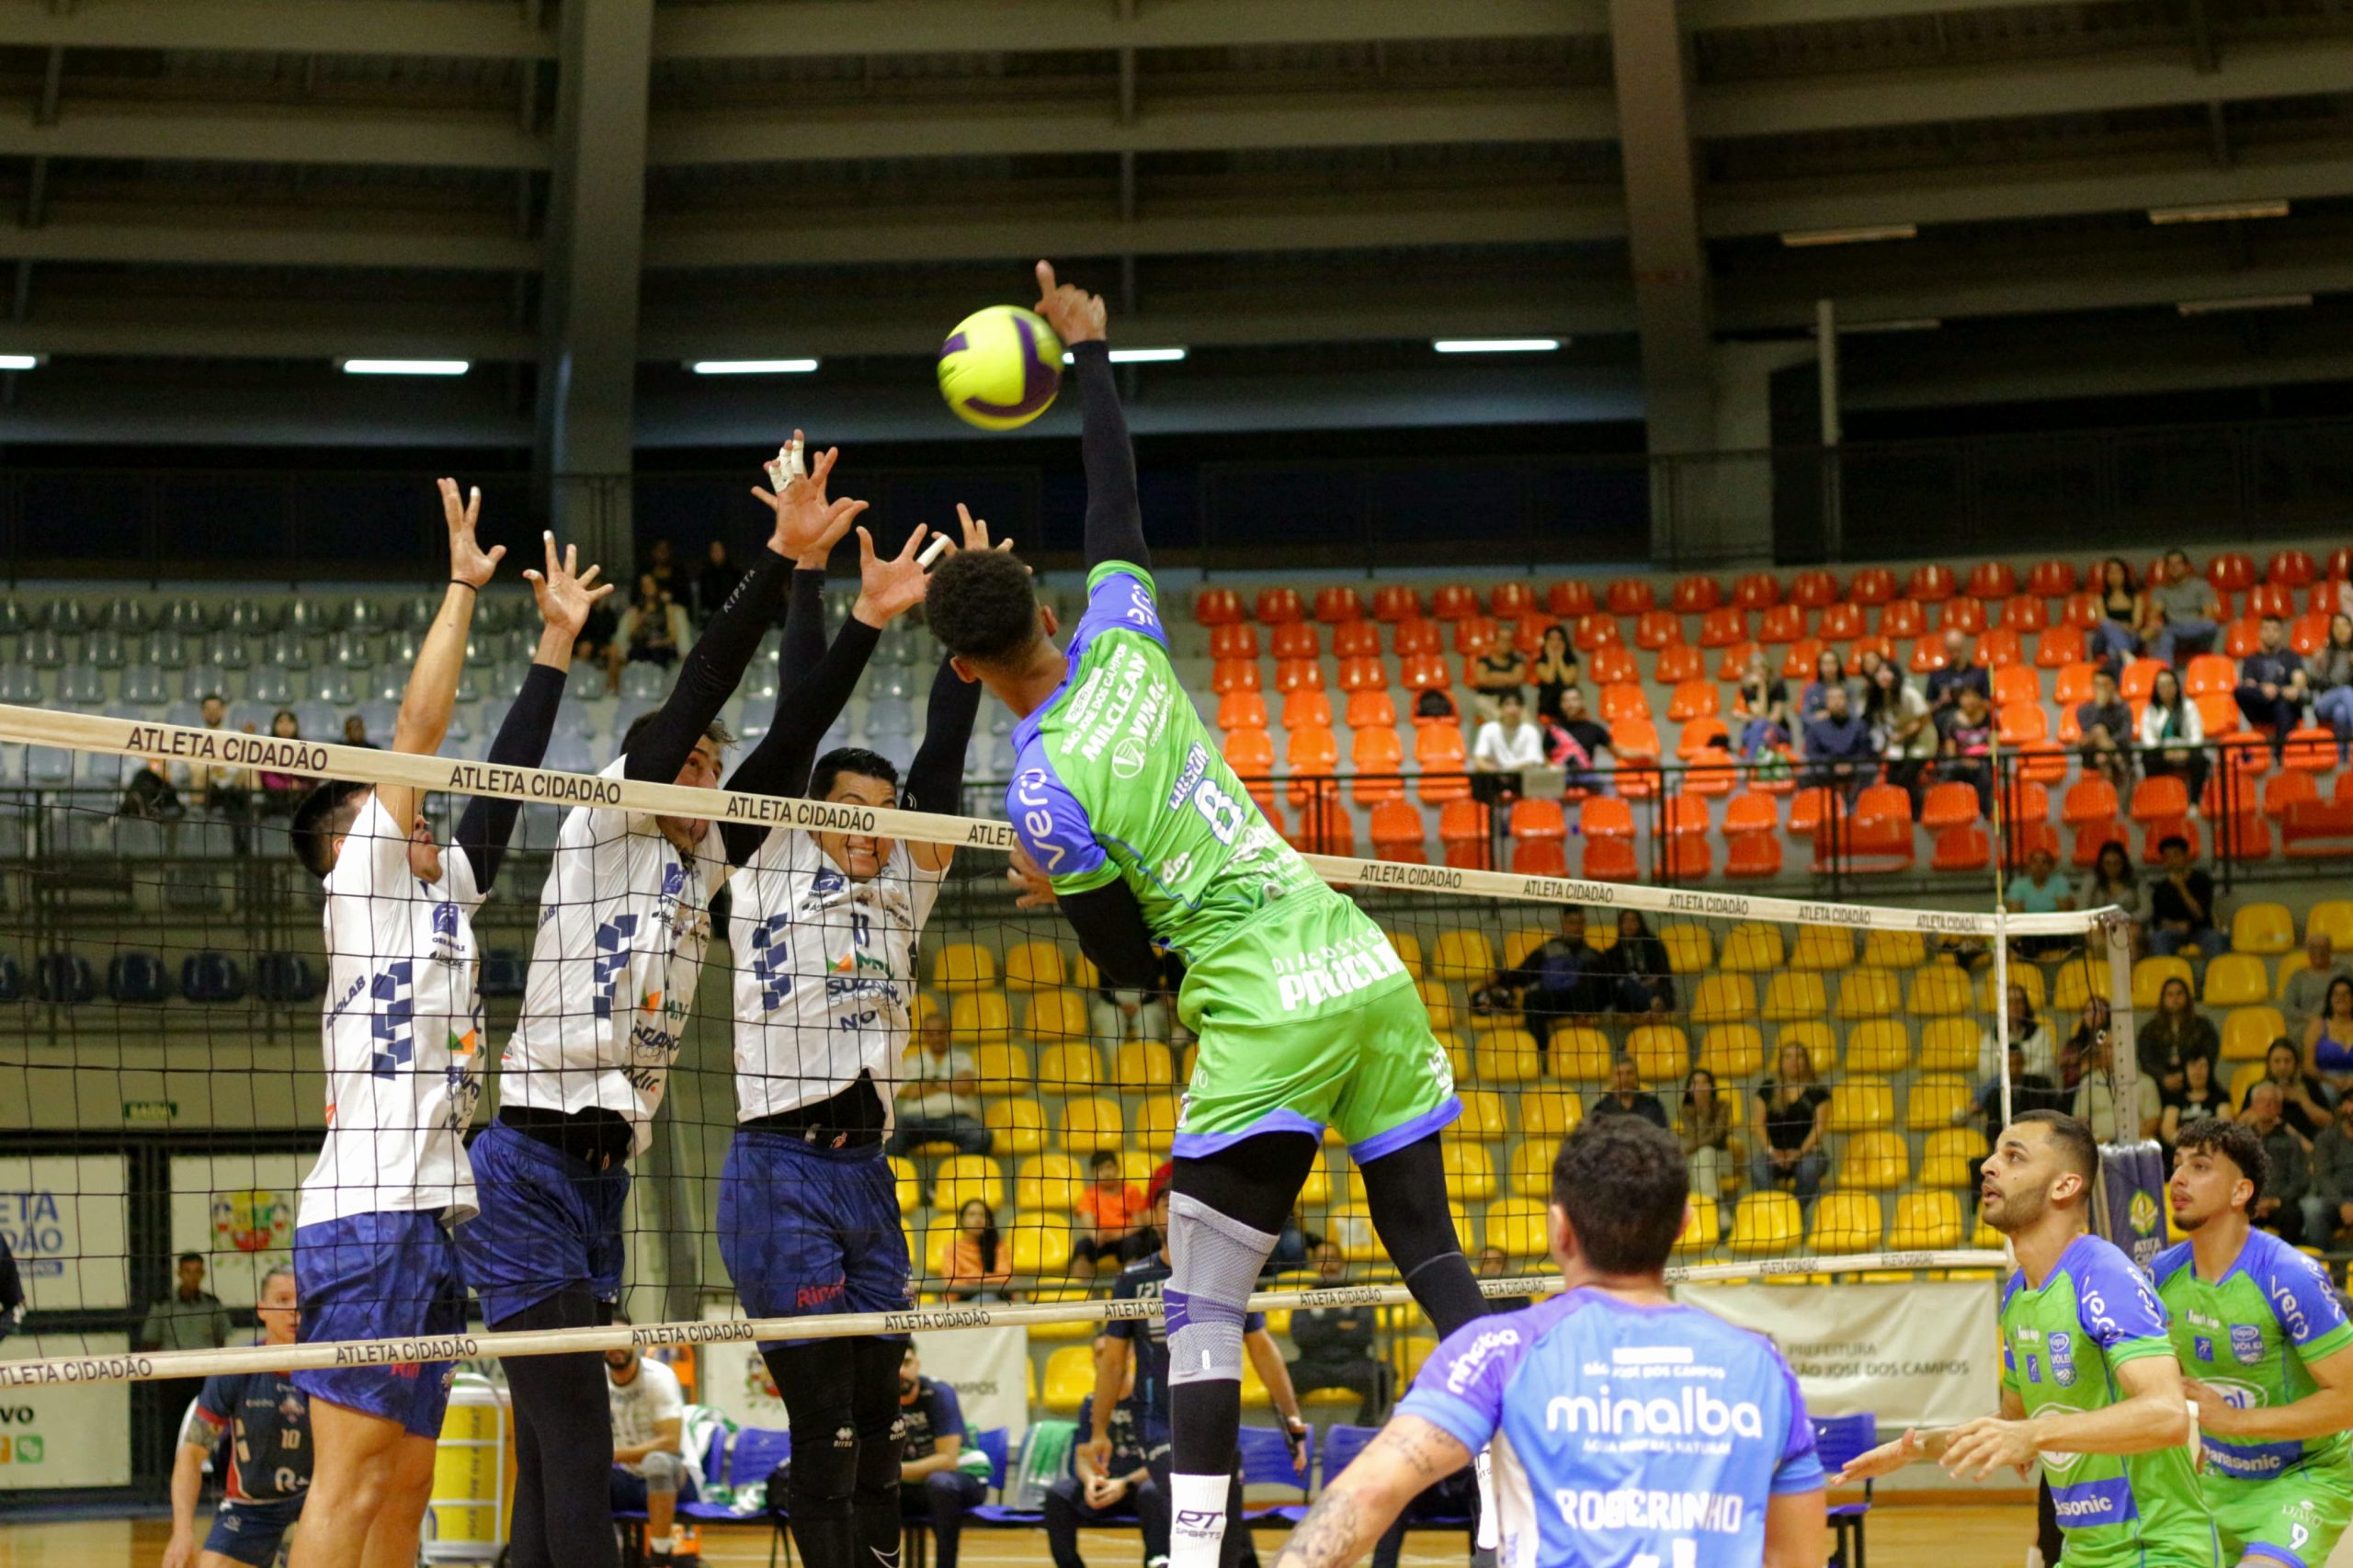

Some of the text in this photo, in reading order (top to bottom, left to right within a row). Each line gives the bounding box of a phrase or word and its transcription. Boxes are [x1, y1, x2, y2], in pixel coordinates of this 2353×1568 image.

[723, 569, 756, 613] KIPSTA
[1061, 642, 1127, 755] SÃO JOSÉ DOS CAMPOS
[1081, 652, 1147, 763] MILCLEAN
[127, 727, 327, 772] ATLETA CIDADÃO
[449, 767, 621, 805] ATLETA CIDADÃO
[1169, 740, 1210, 811] WILSON
[726, 796, 875, 832] ATLETA CIDADÃO
[1192, 777, 1245, 846] 8
[967, 824, 1016, 846] ATLET
[1359, 864, 1462, 890] ATLETA CIDADÃO
[1523, 880, 1613, 903] ATLETA CIDADÃO
[1668, 893, 1749, 915] ATLETA CIDADÃO
[1798, 905, 1871, 926] ATLETA CIDADÃO
[1916, 915, 1946, 929] ATLETA
[0, 1191, 59, 1222] ETA
[1759, 1260, 1785, 1275] ATLETA
[1300, 1287, 1382, 1307] ATLETA CIDADÃO
[1481, 1279, 1546, 1297] LETA CIDADÃO
[885, 1309, 991, 1331] ATLETA CIDADÃO
[1105, 1303, 1145, 1318] ATLETA
[631, 1320, 754, 1346] ATLETA CIDADÃO
[336, 1335, 478, 1365] ATLETA CIDADÃO
[0, 1354, 153, 1386] TLETA CIDADÃO
[1824, 1358, 1861, 1377] JOSÉ
[1867, 1360, 1899, 1376] DOS
[1902, 1359, 1970, 1377] CAMPOS
[954, 1381, 1000, 1396] MPOS
[1546, 1382, 1763, 1440] minalba
[281, 1428, 301, 1450] 10
[2202, 1445, 2280, 1471] Panasonic
[1176, 1509, 1223, 1528] RT
[1555, 1488, 1744, 1533] ROGERINHO
[2052, 1494, 2113, 1517] sonic
[2289, 1521, 2310, 1551] 9
